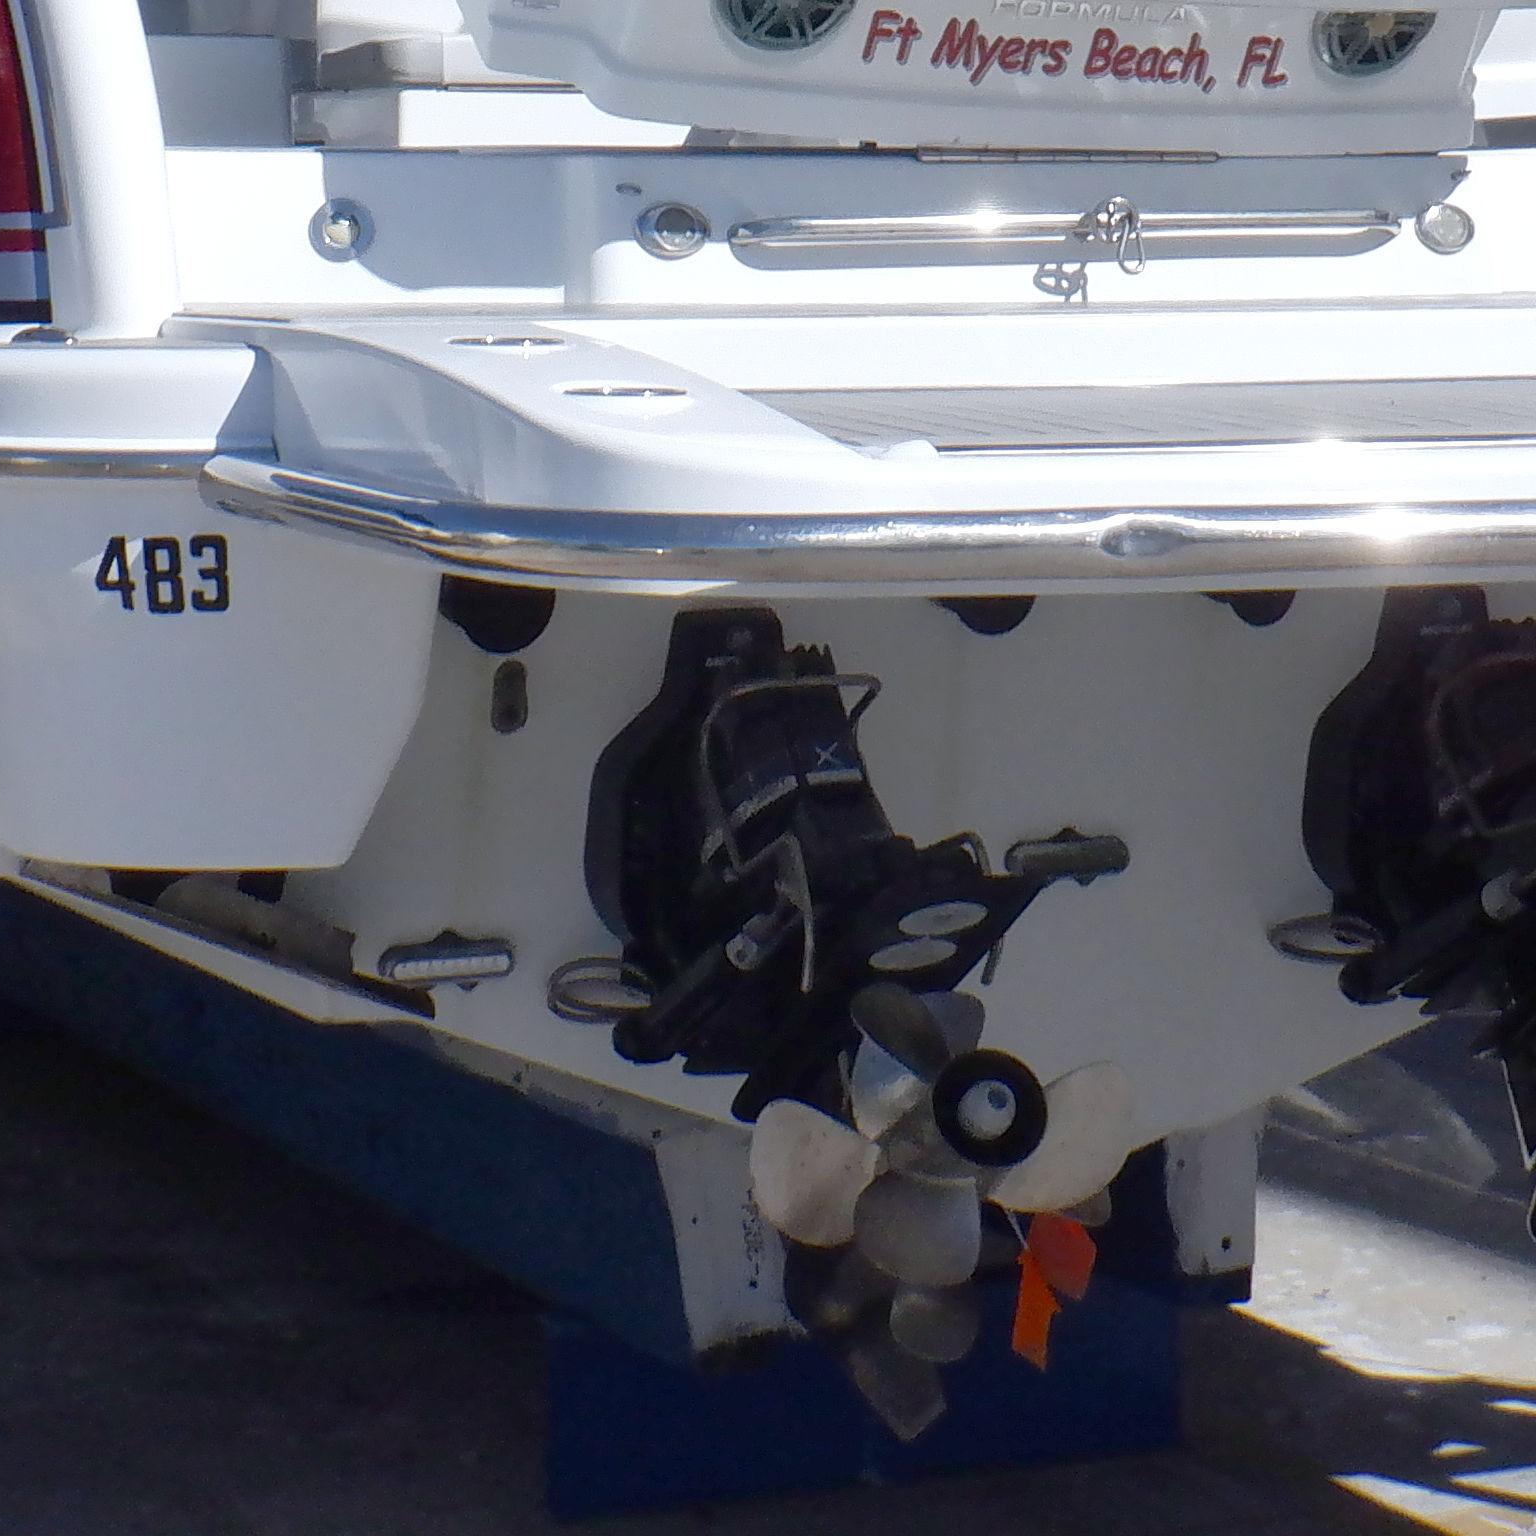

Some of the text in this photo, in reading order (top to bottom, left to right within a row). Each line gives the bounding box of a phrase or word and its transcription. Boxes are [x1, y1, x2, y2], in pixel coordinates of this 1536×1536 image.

[862, 10, 1288, 94] Ft Myers Beach, FL
[95, 534, 230, 614] 483
